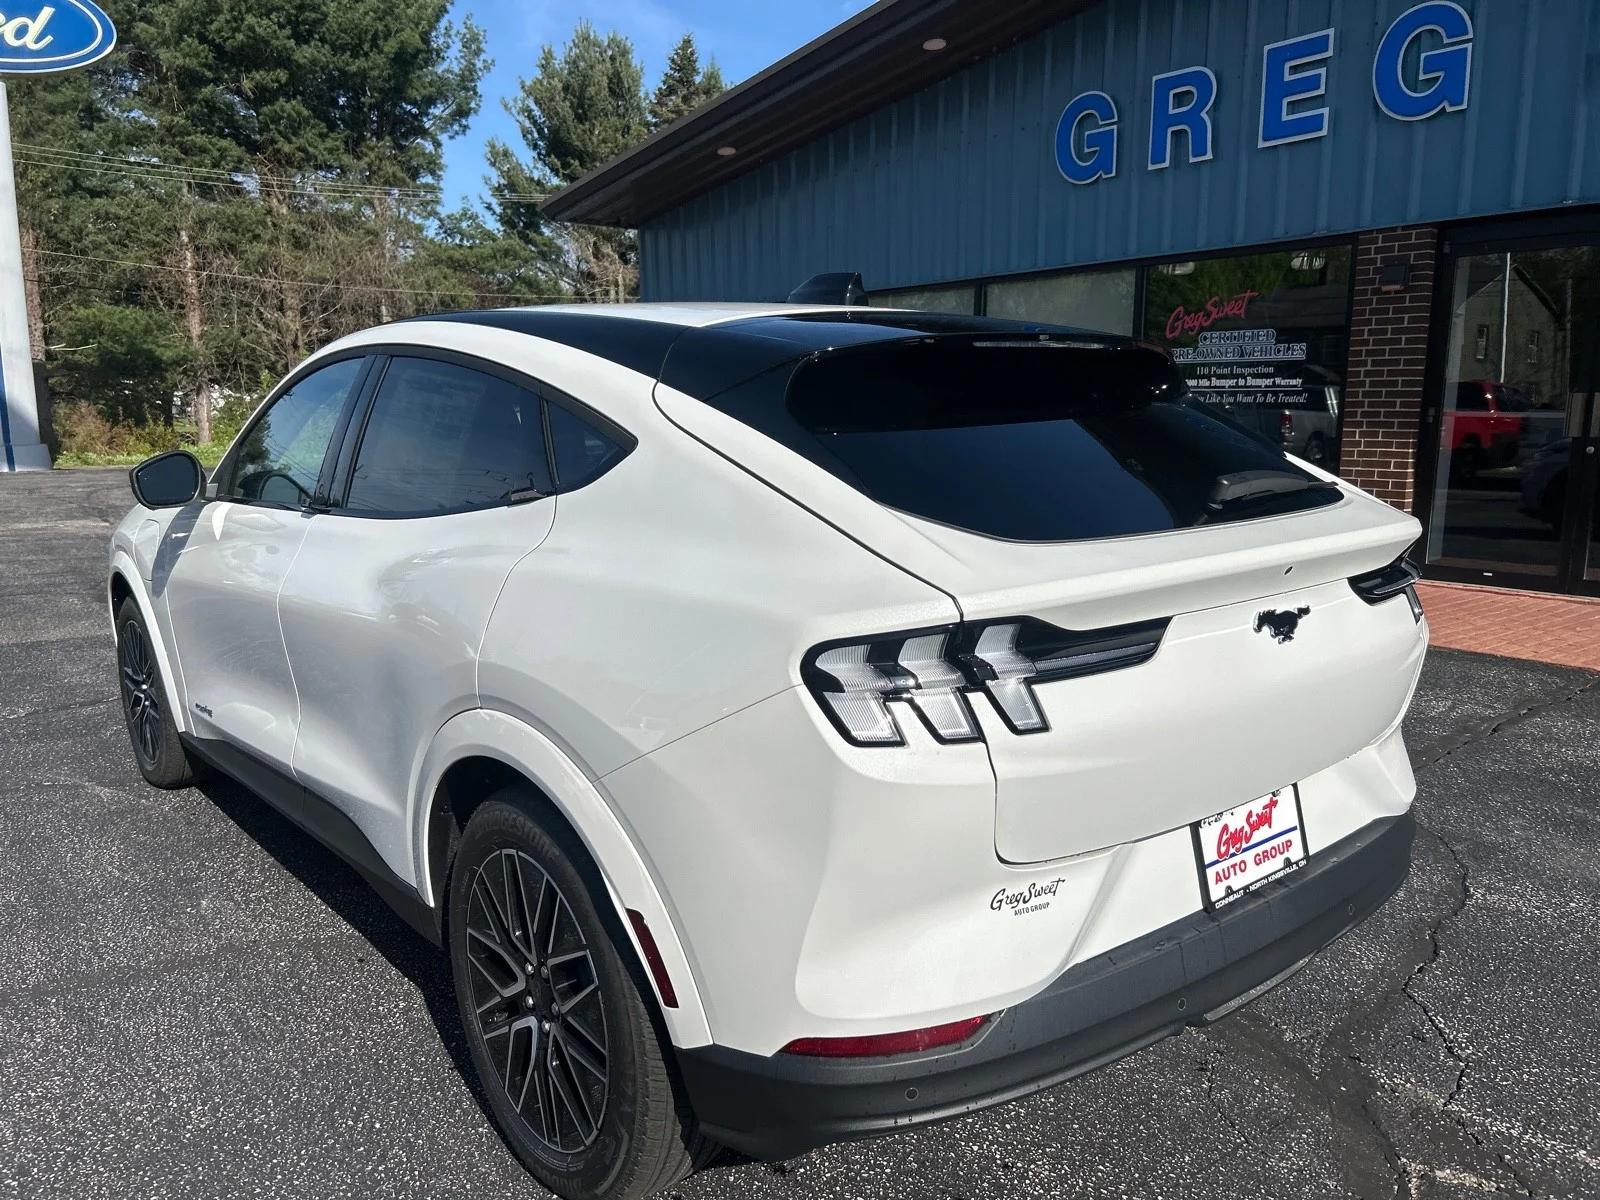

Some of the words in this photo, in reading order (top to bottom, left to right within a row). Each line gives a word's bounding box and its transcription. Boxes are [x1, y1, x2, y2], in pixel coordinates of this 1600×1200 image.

[1055, 1, 1474, 185] GREG
[1166, 306, 1204, 339] Greg
[1201, 289, 1259, 327] Sweet
[1198, 329, 1276, 345] CERTIFIED
[1241, 343, 1306, 358] VEHICLES
[1197, 366, 1208, 375] 110
[1211, 366, 1231, 375] Point
[1233, 365, 1274, 375] Inspection
[1211, 377, 1237, 388] Bumper
[1238, 378, 1245, 386] to
[1246, 376, 1274, 388] Bumper
[1275, 377, 1302, 387] Warranty
[1206, 394, 1220, 403] Like
[1222, 394, 1235, 403] You
[1236, 394, 1254, 403] Want
[1256, 394, 1264, 403] To
[1266, 394, 1275, 403] Be
[1278, 393, 1308, 403] Treated!
[1217, 823, 1244, 859] Greg
[1244, 797, 1278, 844] Sweet
[1215, 860, 1247, 885] AUTO
[1254, 839, 1292, 866] GROUP
[1249, 877, 1268, 892] NORTH
[990, 888, 1024, 911] Greg
[1022, 877, 1066, 904] Sweet
[1014, 907, 1030, 916] AUTO
[1030, 902, 1050, 913] GROUP
